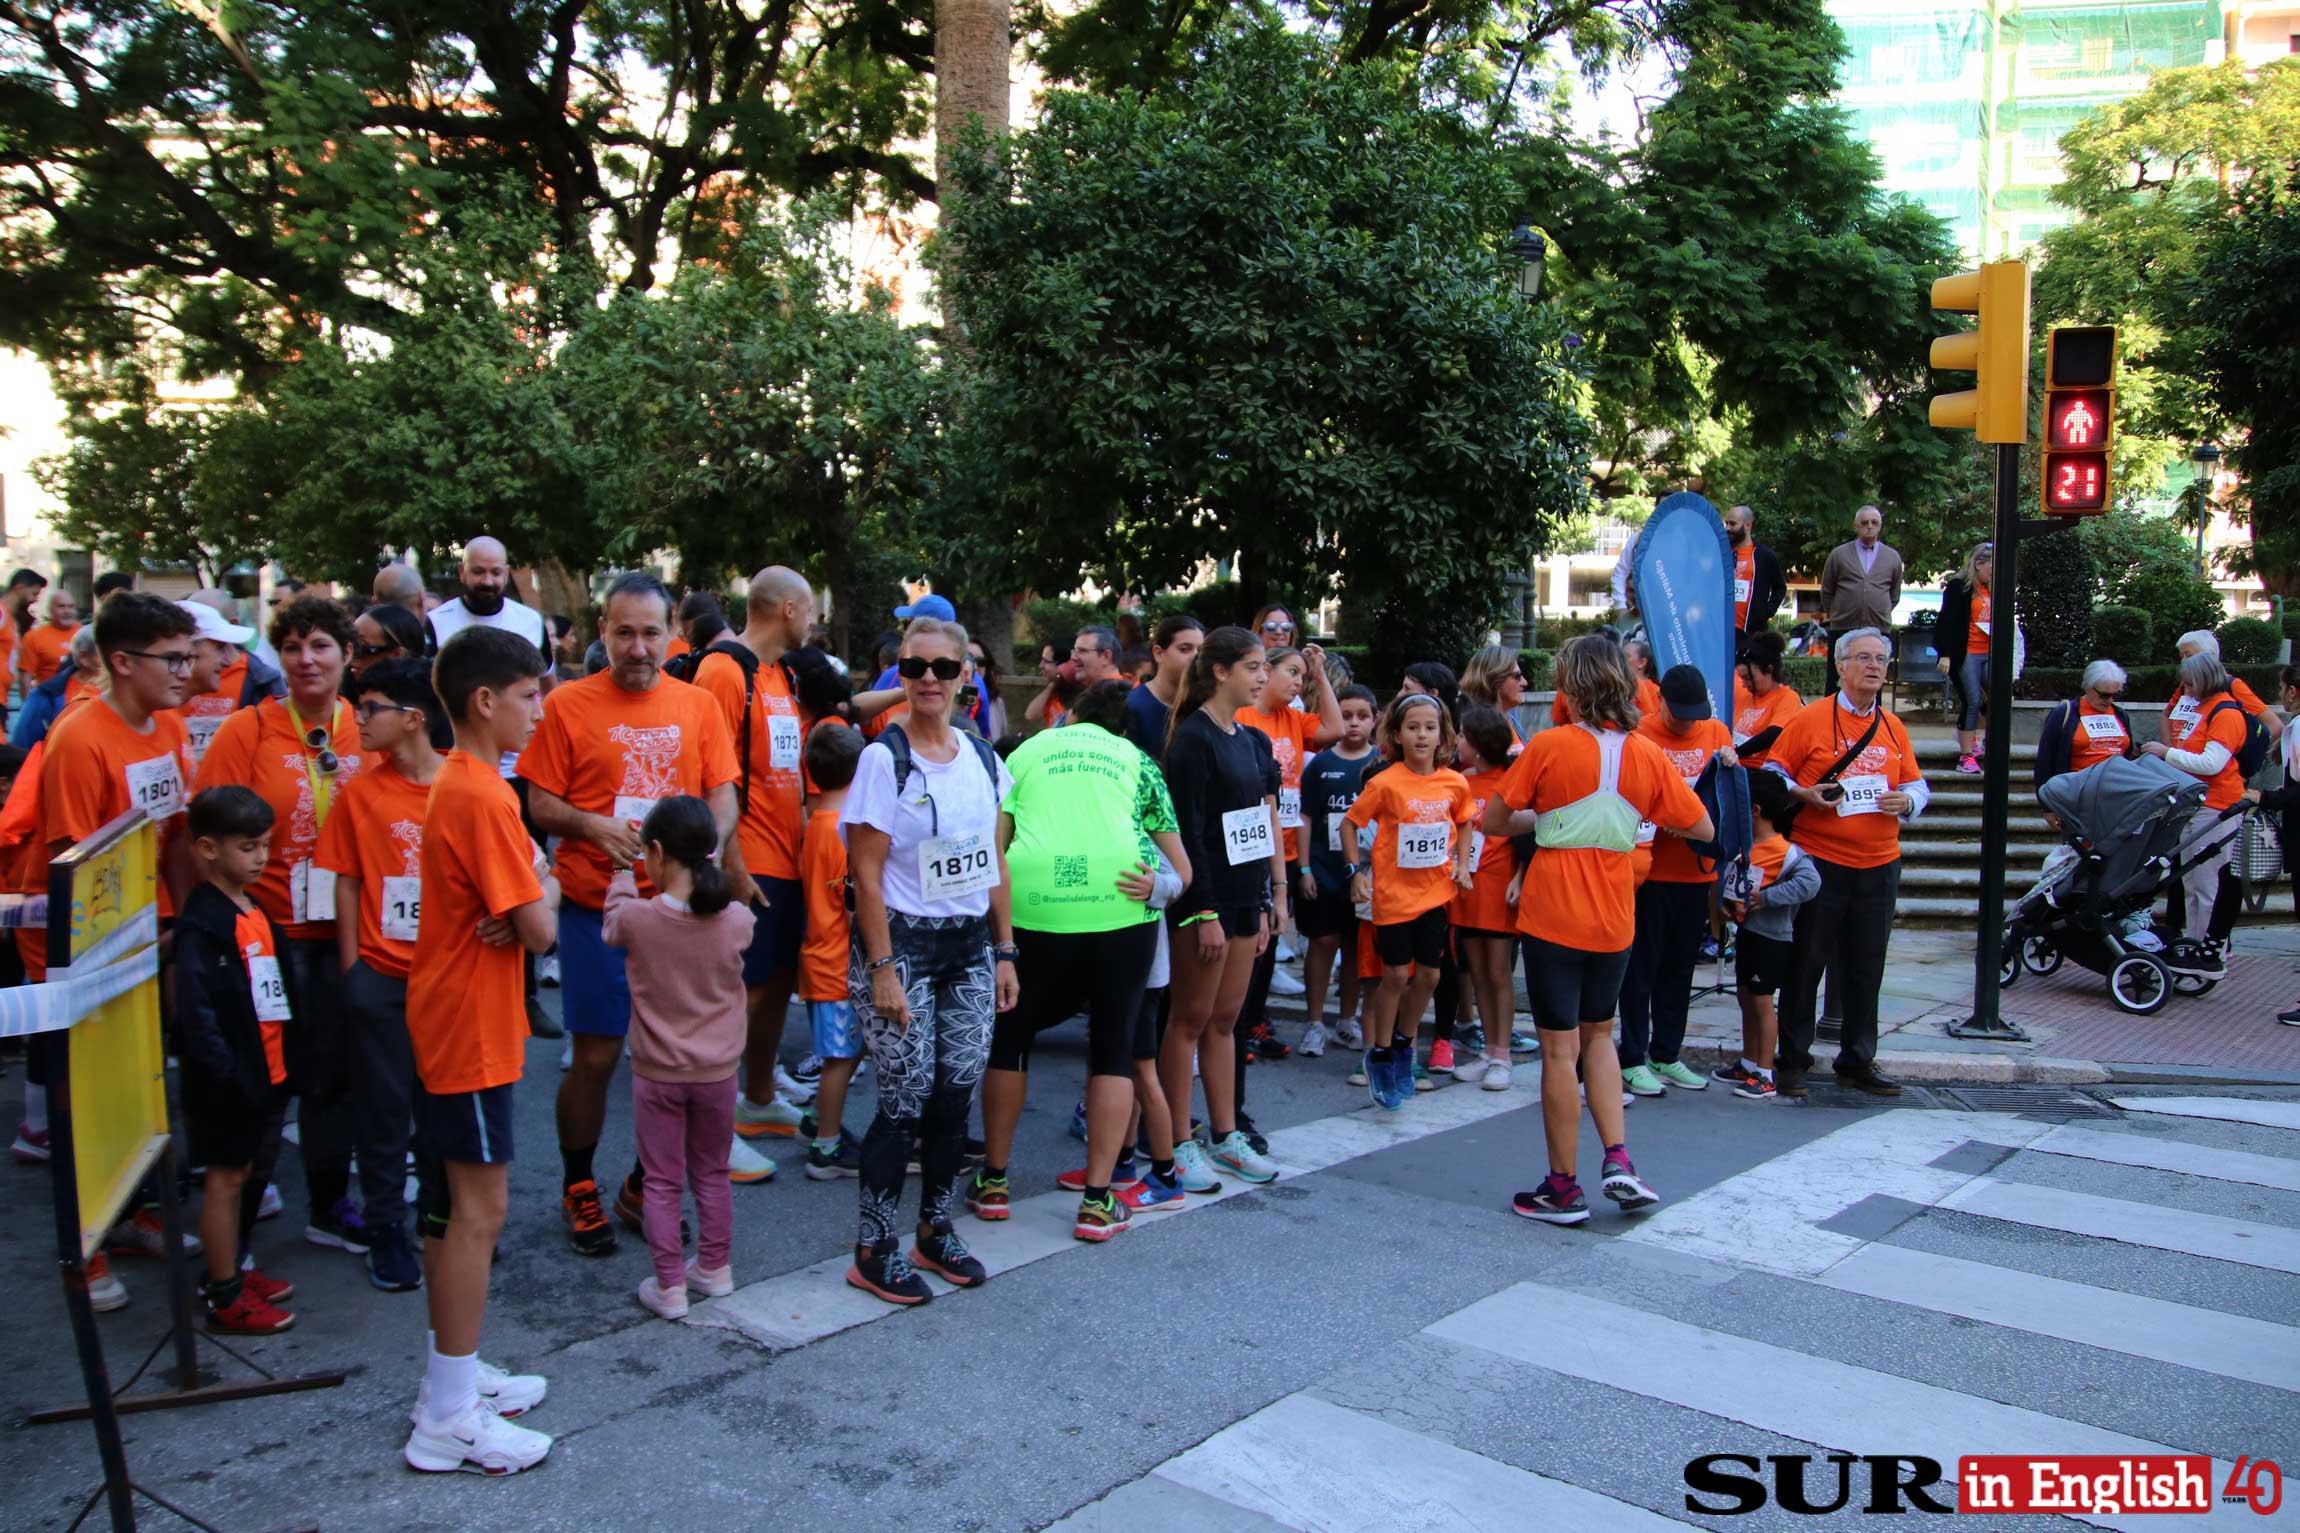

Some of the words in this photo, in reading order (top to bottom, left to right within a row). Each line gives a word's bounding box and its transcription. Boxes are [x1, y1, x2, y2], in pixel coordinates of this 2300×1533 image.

[2059, 466, 2095, 499] 21
[2179, 704, 2197, 713] 192
[189, 732, 214, 746] 17
[774, 735, 798, 750] 1873
[1043, 748, 1084, 764] unidos
[1088, 751, 1127, 772] somos
[1048, 762, 1073, 775] más
[1078, 760, 1119, 780] fuertes
[138, 776, 179, 803] 1801
[1280, 803, 1298, 814] 721
[1230, 824, 1267, 845] 1948
[1405, 837, 1445, 853] 1812
[929, 849, 988, 878] 1870
[393, 901, 421, 919] 18
[260, 980, 286, 998] 18
